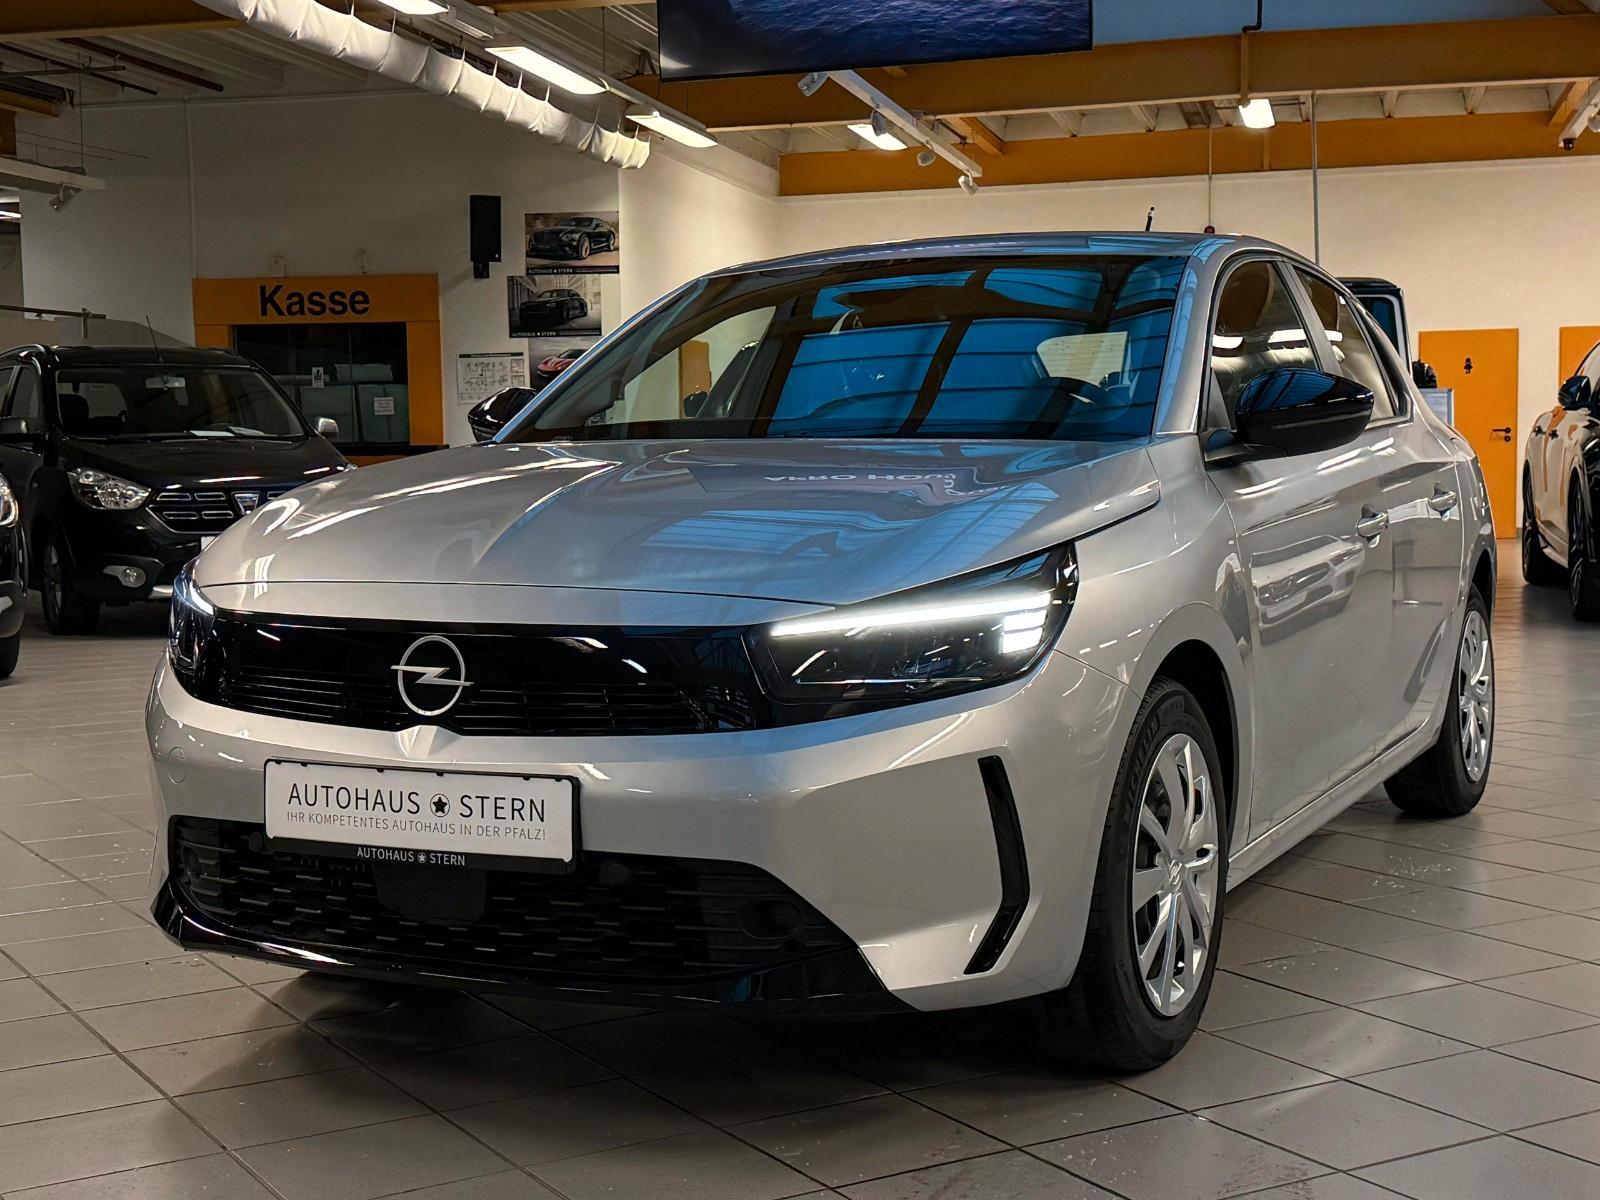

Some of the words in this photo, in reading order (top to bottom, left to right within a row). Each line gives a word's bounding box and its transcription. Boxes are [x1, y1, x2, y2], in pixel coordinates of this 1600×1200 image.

[259, 284, 370, 317] Kasse
[288, 783, 420, 814] AUTOHAUS
[459, 794, 545, 823] STERN
[286, 811, 305, 823] IHR
[308, 812, 389, 830] KOMPETENTES
[392, 818, 456, 835] AUTOHAUS
[460, 825, 472, 836] IN
[476, 825, 500, 838] DER
[504, 826, 546, 841] PFALZ!
[356, 846, 415, 862] AUTOHAUS
[429, 852, 465, 866] STERN
